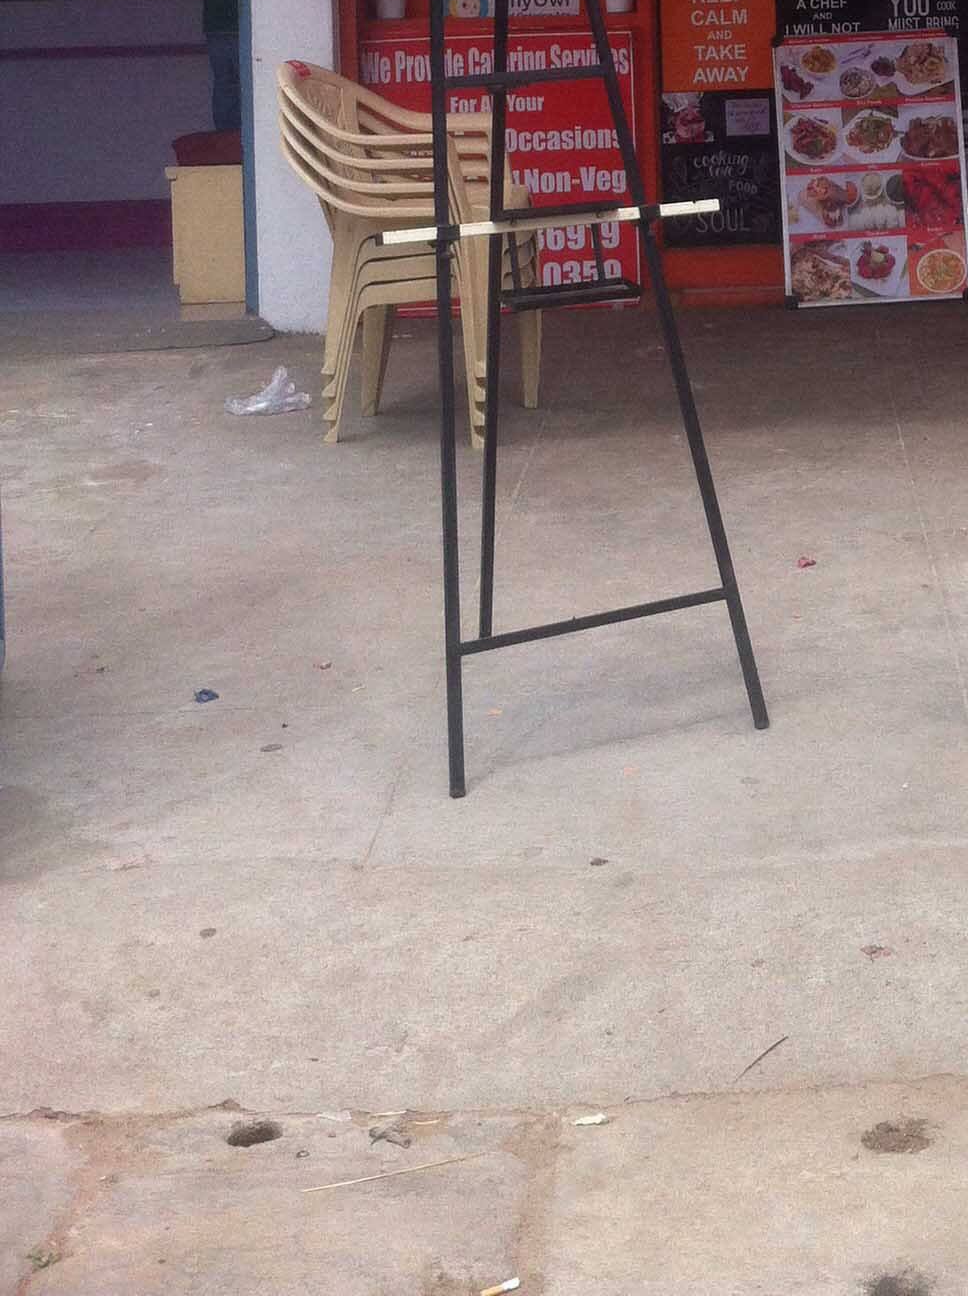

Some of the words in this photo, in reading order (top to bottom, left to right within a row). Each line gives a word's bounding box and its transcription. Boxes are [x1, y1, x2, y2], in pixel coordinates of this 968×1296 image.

[935, 1, 958, 11] COOK
[690, 8, 749, 26] CALM
[812, 12, 833, 21] AND
[887, 17, 921, 33] MUST
[706, 29, 733, 41] AND
[793, 22, 828, 35] WILL
[831, 21, 862, 34] NOT
[693, 43, 748, 61] TAKE
[692, 66, 750, 84] AWAY
[449, 96, 478, 113] For
[506, 94, 546, 113] Your
[695, 207, 752, 234] SOUL
